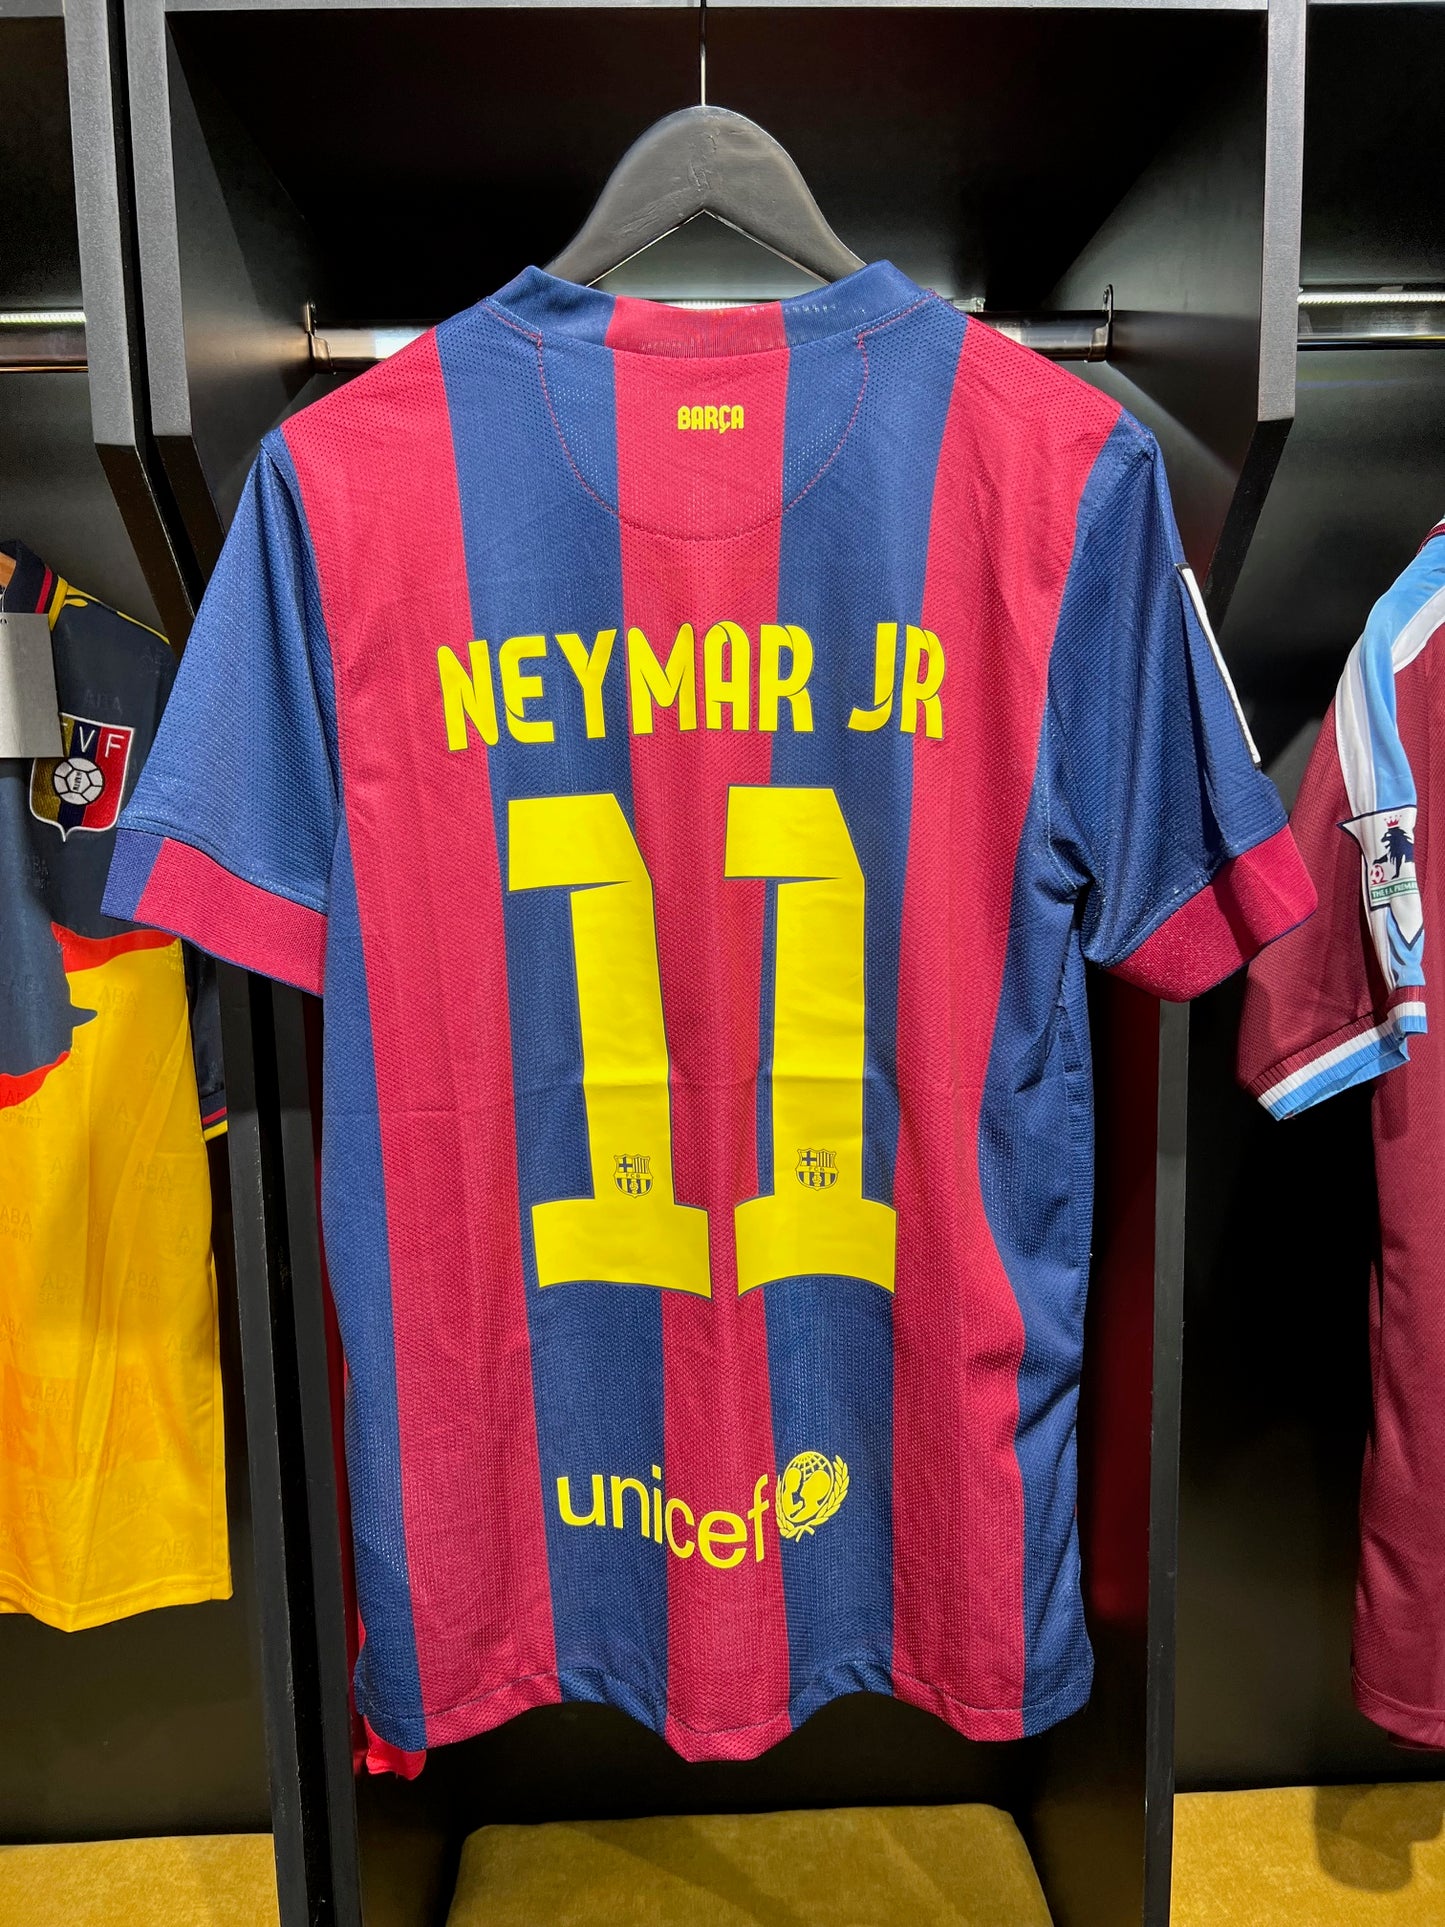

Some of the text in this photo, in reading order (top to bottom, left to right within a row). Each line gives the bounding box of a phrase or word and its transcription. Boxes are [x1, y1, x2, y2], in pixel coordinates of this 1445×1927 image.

[677, 405, 744, 434] BARÇA
[438, 621, 945, 751] NEYMAR JR
[507, 785, 898, 1299] 11
[556, 1463, 770, 1569] unicef
